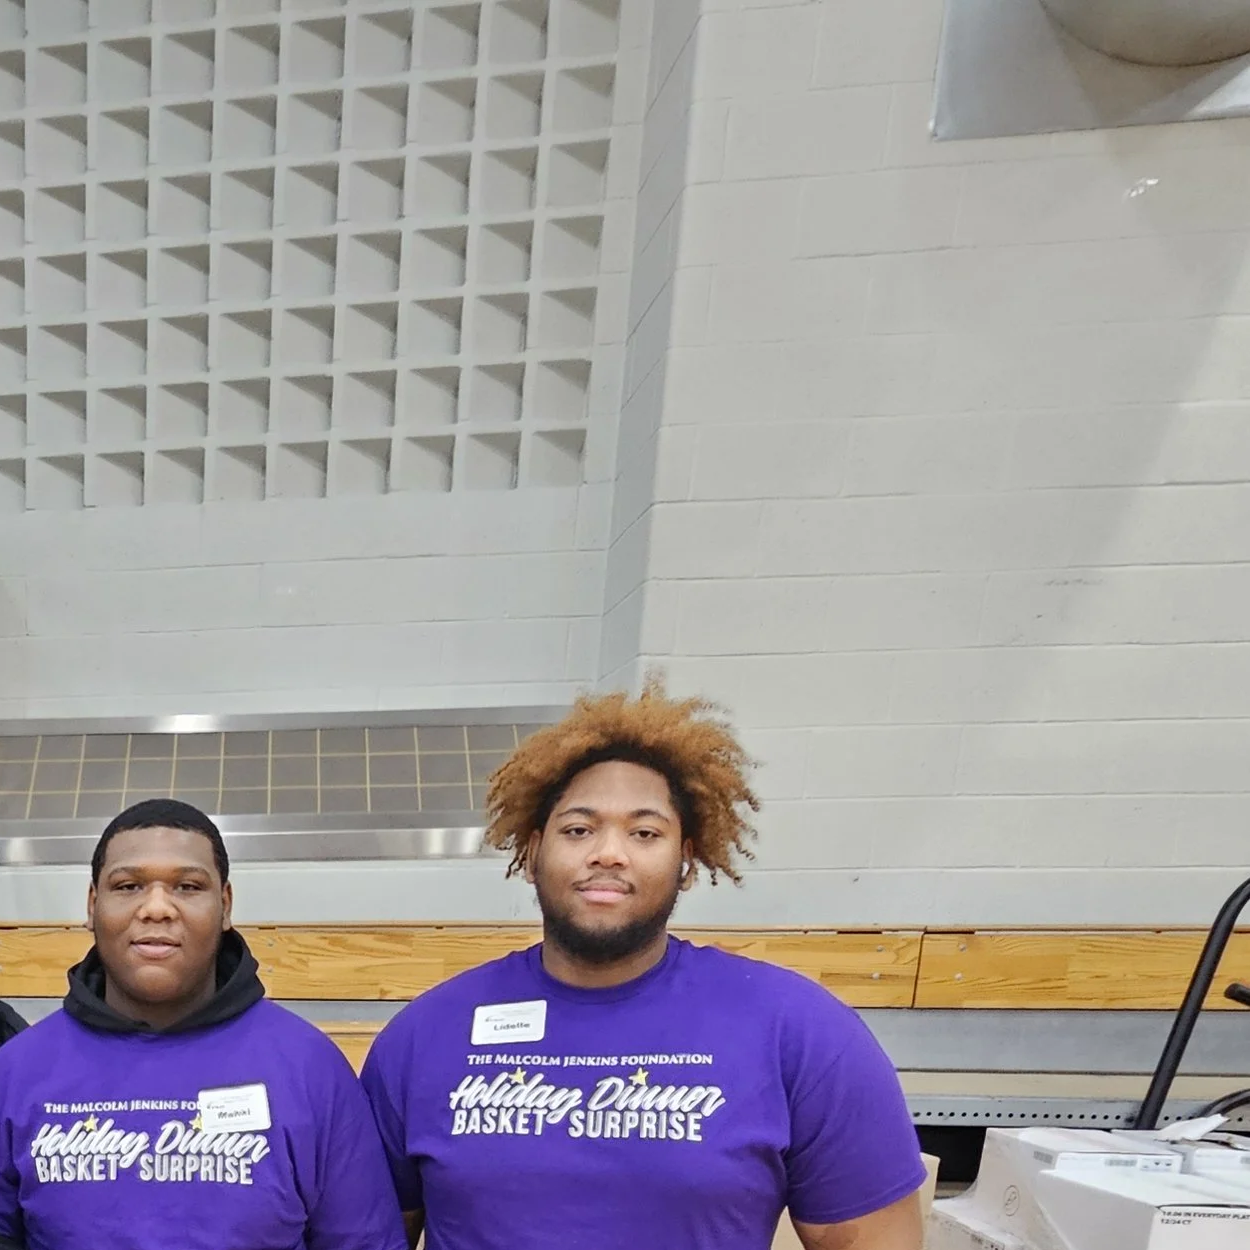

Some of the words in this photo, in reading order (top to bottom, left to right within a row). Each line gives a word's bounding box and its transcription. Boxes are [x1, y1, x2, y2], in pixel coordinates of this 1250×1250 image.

[467, 1054, 493, 1066] THE
[494, 1054, 561, 1067] MALCOLM
[563, 1055, 618, 1067] JENKINS
[620, 1053, 713, 1066] FOUNDATION
[44, 1102, 69, 1114] THE
[70, 1100, 129, 1114] MALCOLM
[130, 1099, 179, 1112] JENKINS
[449, 1072, 583, 1124] Holiday
[587, 1076, 727, 1117] Dinner
[451, 1107, 549, 1136] BASKET
[567, 1109, 703, 1142] SURPRISE
[31, 1117, 150, 1169] Holiday
[155, 1119, 270, 1163] Dinner
[35, 1153, 121, 1183] BASKET
[139, 1153, 253, 1185] SURPRISE
